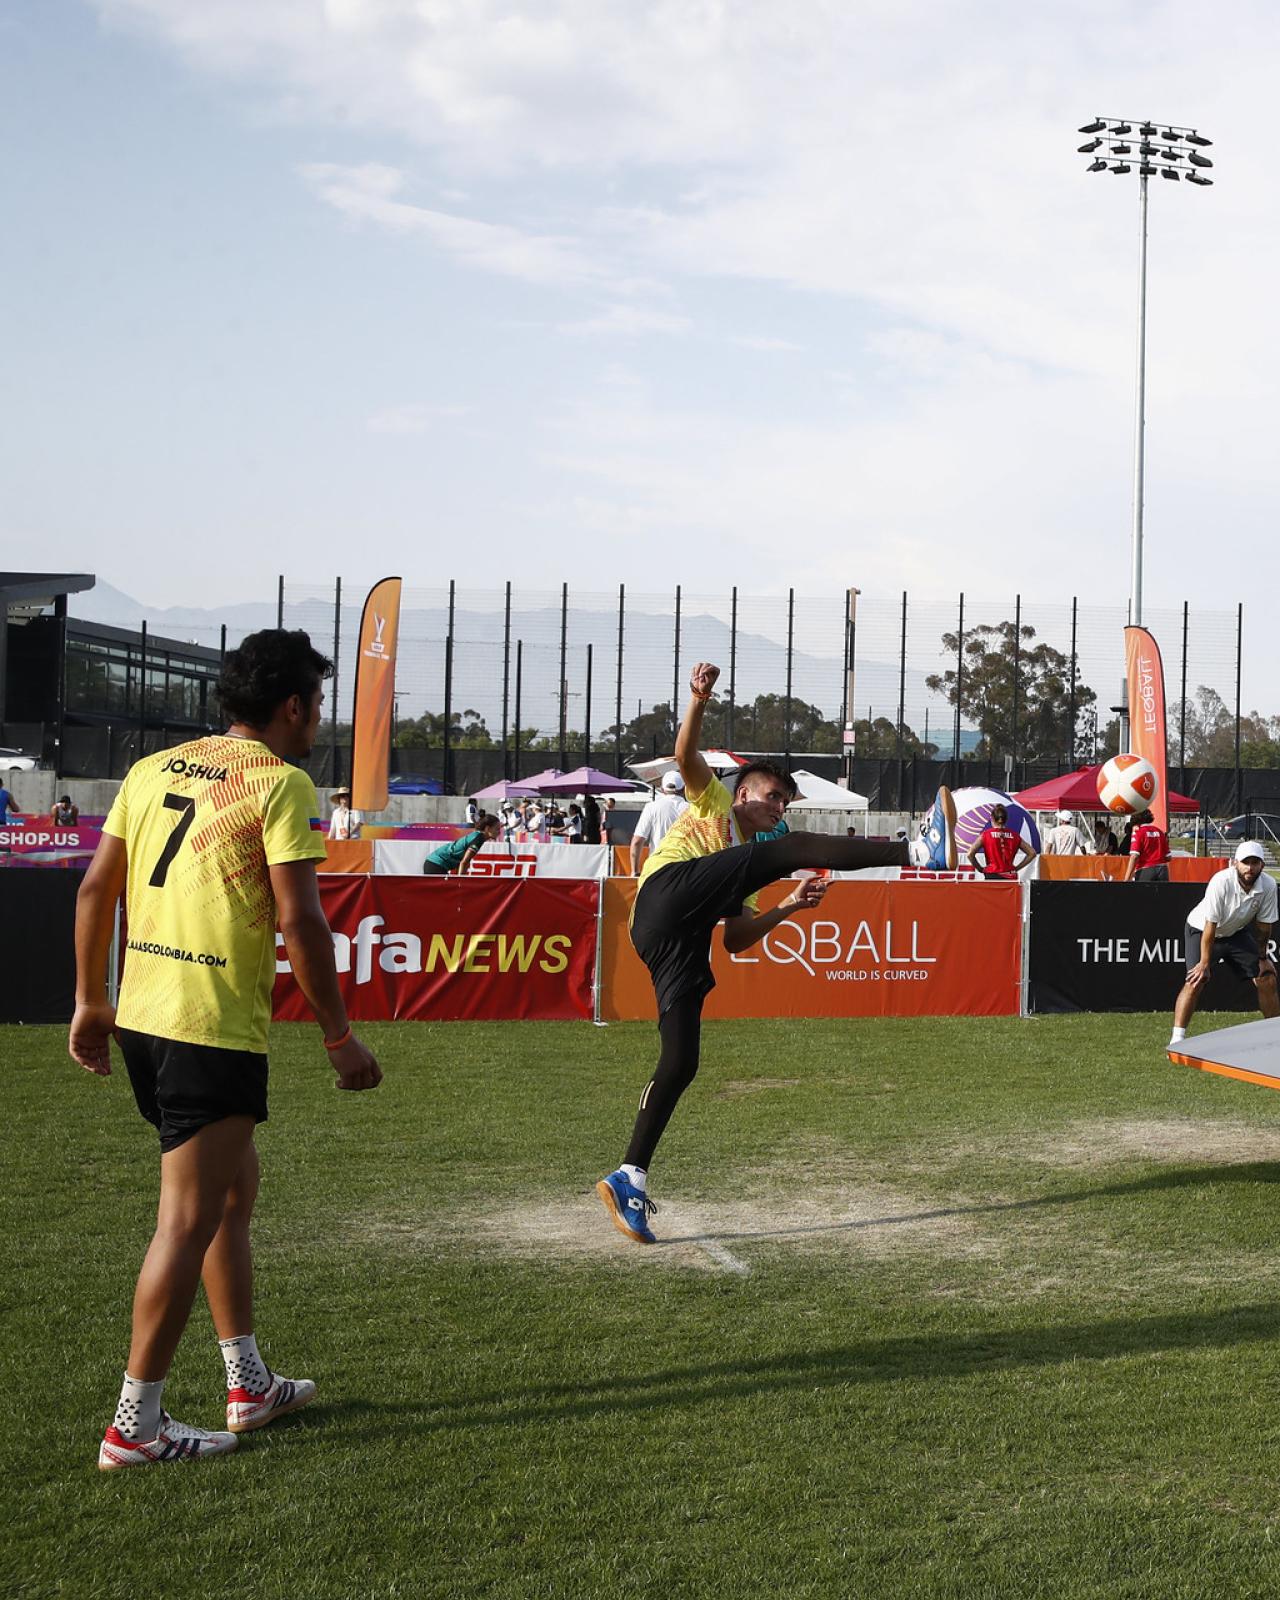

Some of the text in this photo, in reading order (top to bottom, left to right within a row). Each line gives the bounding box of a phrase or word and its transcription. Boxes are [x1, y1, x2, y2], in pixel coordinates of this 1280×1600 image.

[161, 758, 228, 782] JOSHUA
[149, 792, 196, 888] 7
[1077, 938, 1129, 963] THE
[825, 970, 928, 981] WORLD IS CURVED
